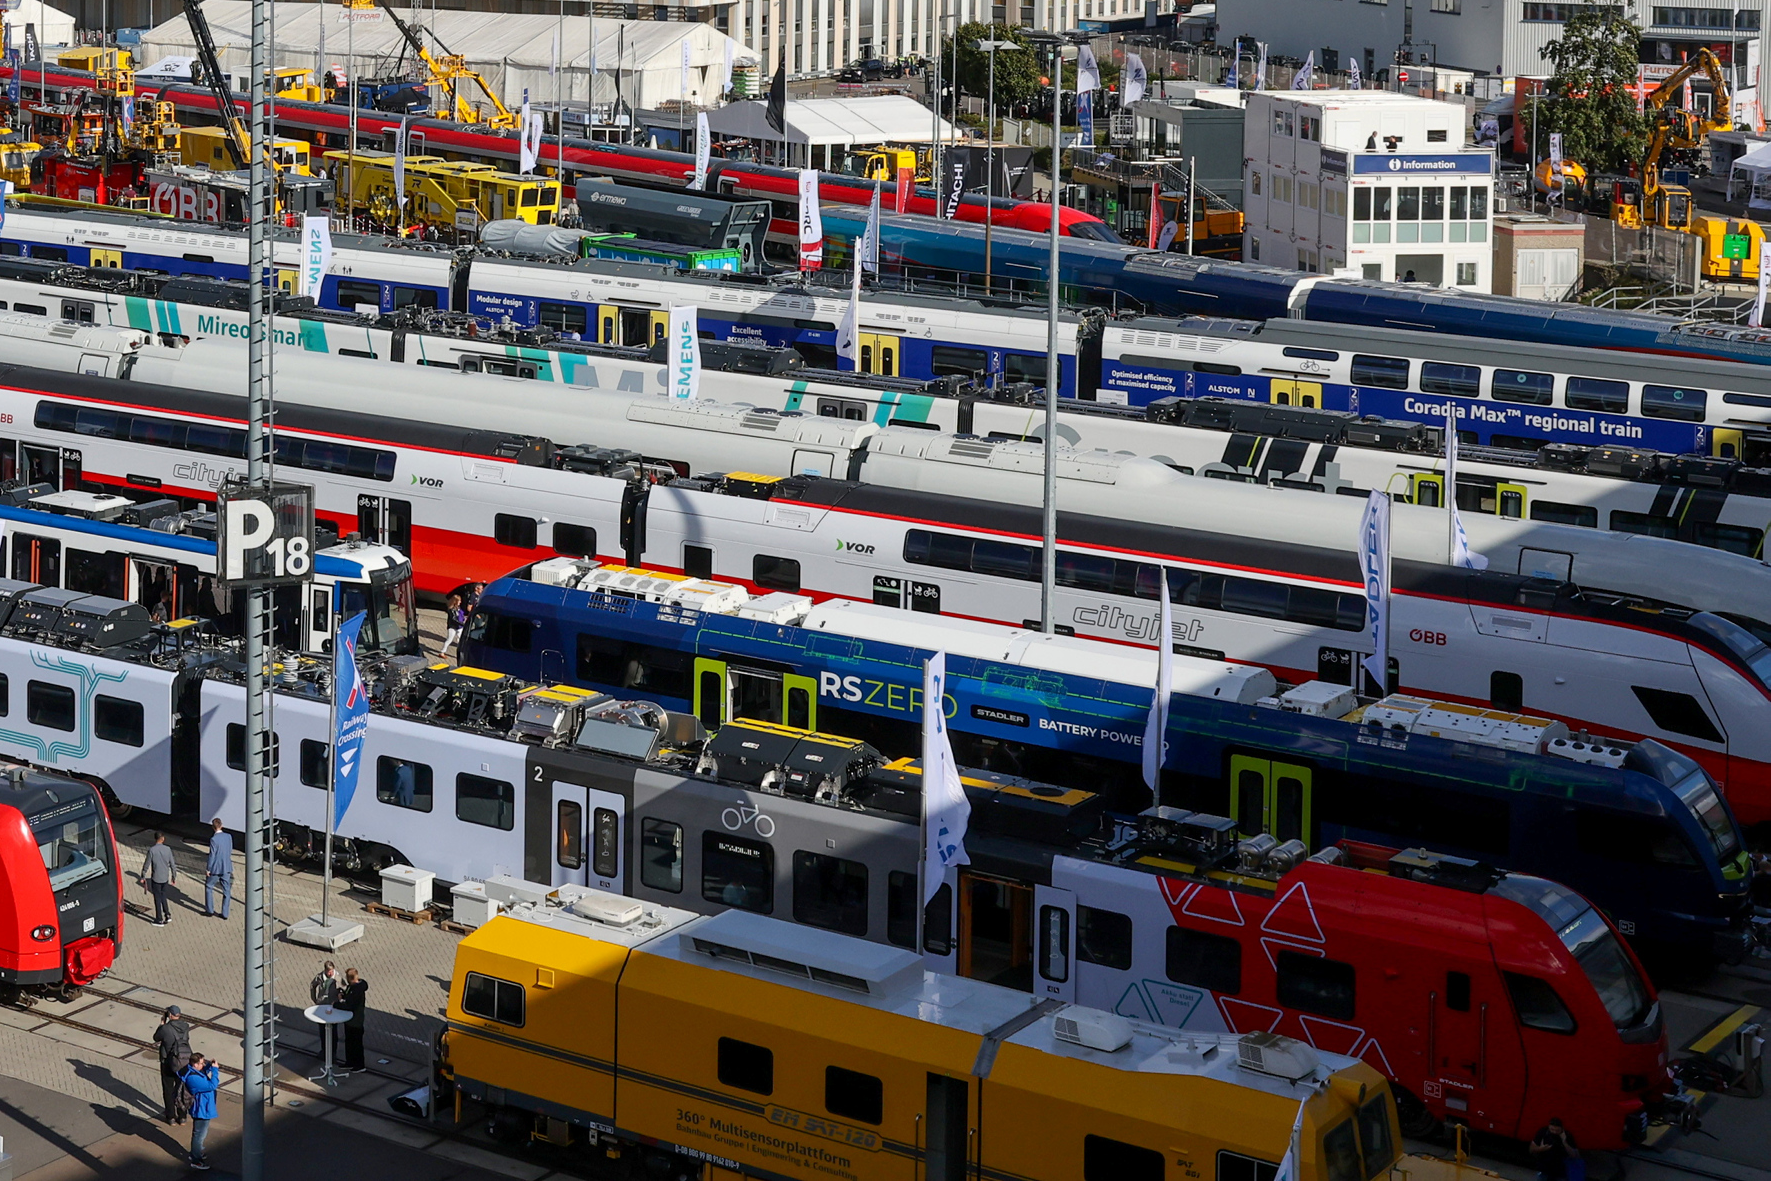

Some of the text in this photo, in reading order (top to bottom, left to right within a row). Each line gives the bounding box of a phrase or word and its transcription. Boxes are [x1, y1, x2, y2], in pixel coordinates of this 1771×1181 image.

[1403, 159, 1457, 171] Information
[599, 193, 627, 206] ermewa
[945, 162, 964, 221] HITACHI
[476, 294, 524, 310] Modular design
[485, 306, 506, 314] ALSTOM
[197, 314, 251, 340] Mireo
[731, 325, 763, 337] Excellent
[726, 335, 768, 348] accessibility
[1111, 369, 1174, 385] Optimised efficiency
[1116, 378, 1149, 390] maximised
[1149, 381, 1177, 394] capacity
[1208, 384, 1241, 395] ALSTOM
[1403, 396, 1466, 419] Coradia
[1524, 411, 1595, 435] regional
[1599, 418, 1643, 439] train
[418, 477, 445, 489] VOR
[227, 499, 311, 581] P 18
[845, 541, 877, 556] VOR
[1073, 603, 1205, 642] cityjet
[1409, 627, 1448, 646] ÖBB
[976, 708, 1025, 724] STADLER
[342, 713, 368, 736] Railway
[1039, 717, 1098, 740] BATTERY
[337, 725, 368, 747] Crossing
[534, 765, 544, 783] 2
[1169, 997, 1191, 1008] Diesel
[1439, 1077, 1475, 1091] STADLER
[677, 1108, 852, 1169] 360° Multisensorplattform
[676, 1122, 713, 1140] Bahnbau
[714, 1132, 745, 1150] Gruppe
[752, 1144, 802, 1168] Engineering
[812, 1160, 859, 1181] Consulting
